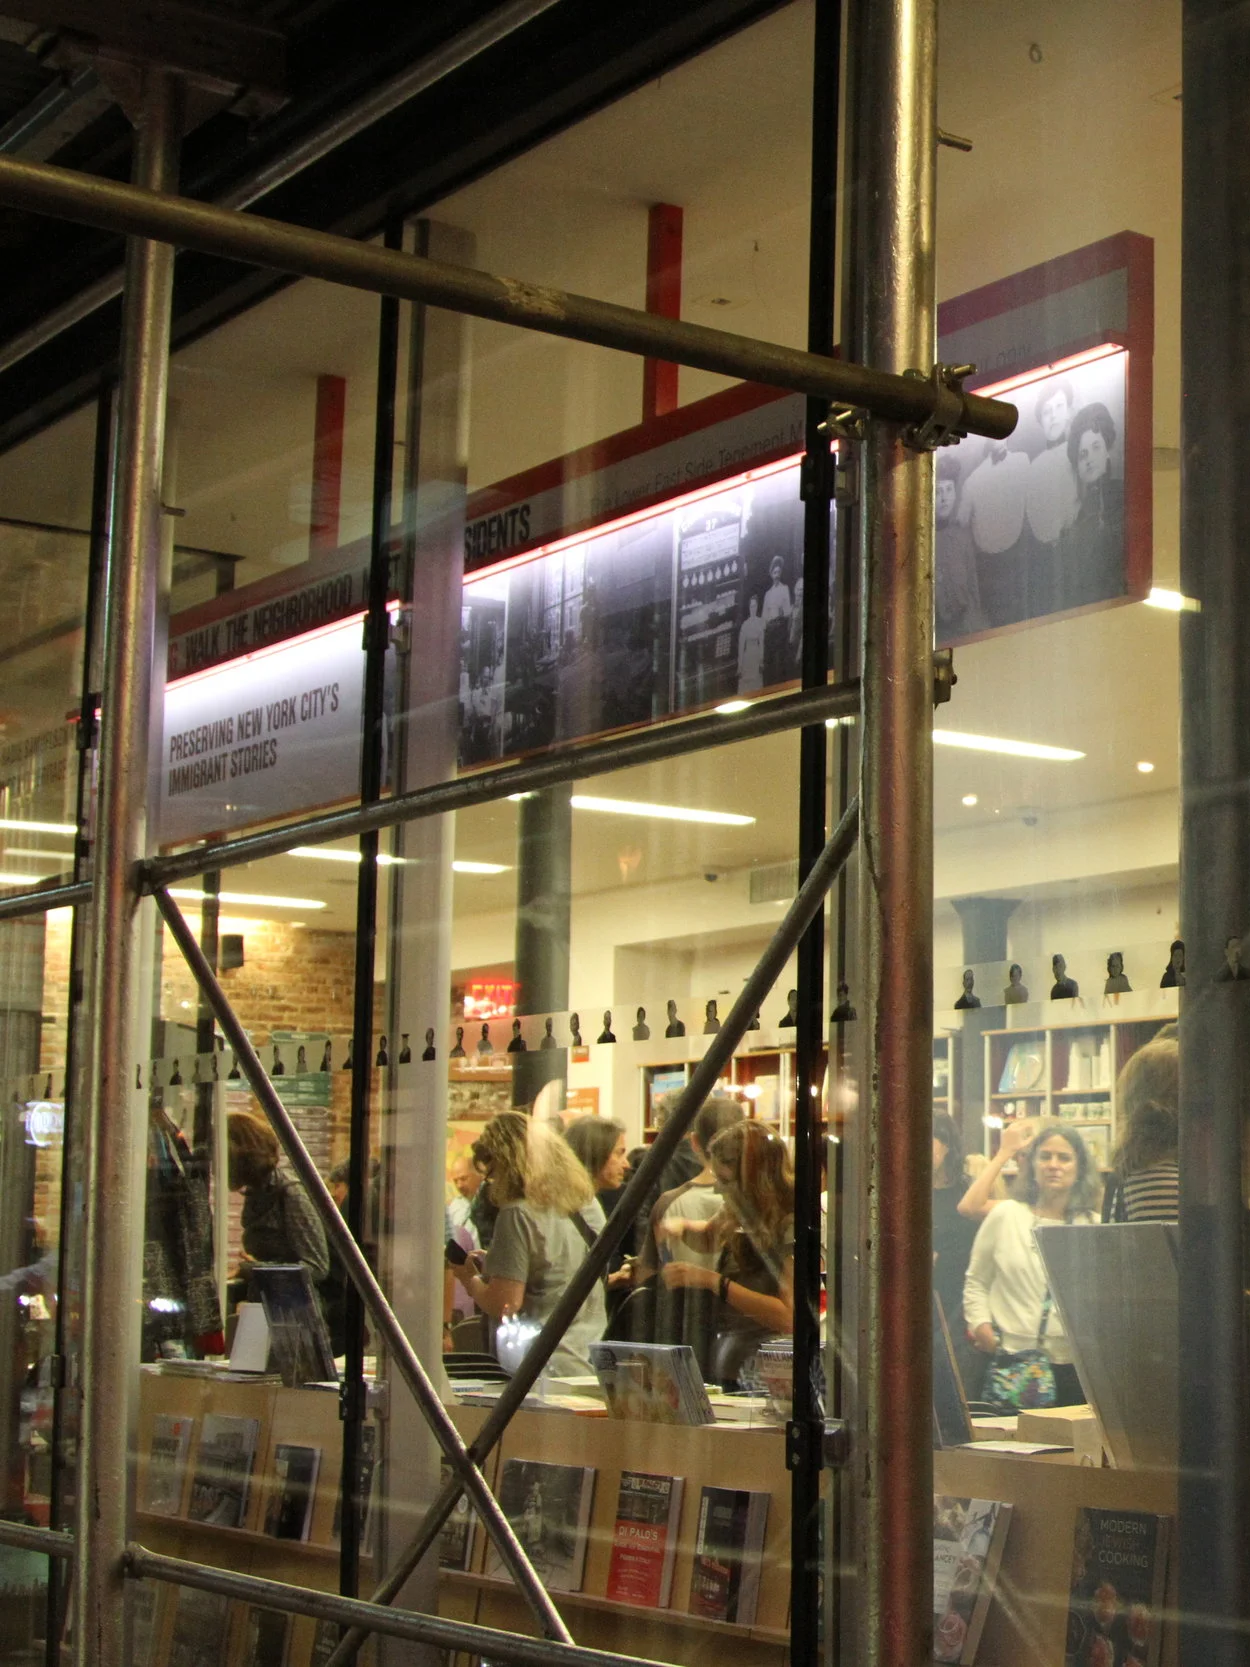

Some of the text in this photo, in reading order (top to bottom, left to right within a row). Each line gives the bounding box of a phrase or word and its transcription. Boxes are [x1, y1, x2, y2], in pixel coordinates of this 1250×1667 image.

[225, 614, 249, 653] THE
[252, 573, 353, 642] NEIGHBORHOOD
[169, 682, 341, 764] PRESERVING NEW YORK CITY'S
[168, 738, 278, 798] IMMIGRANT STORIES
[471, 984, 513, 1006] EXIT
[629, 1527, 659, 1541] PALO'S
[1100, 1519, 1148, 1536] MODERN
[1098, 1550, 1149, 1569] COOKING
